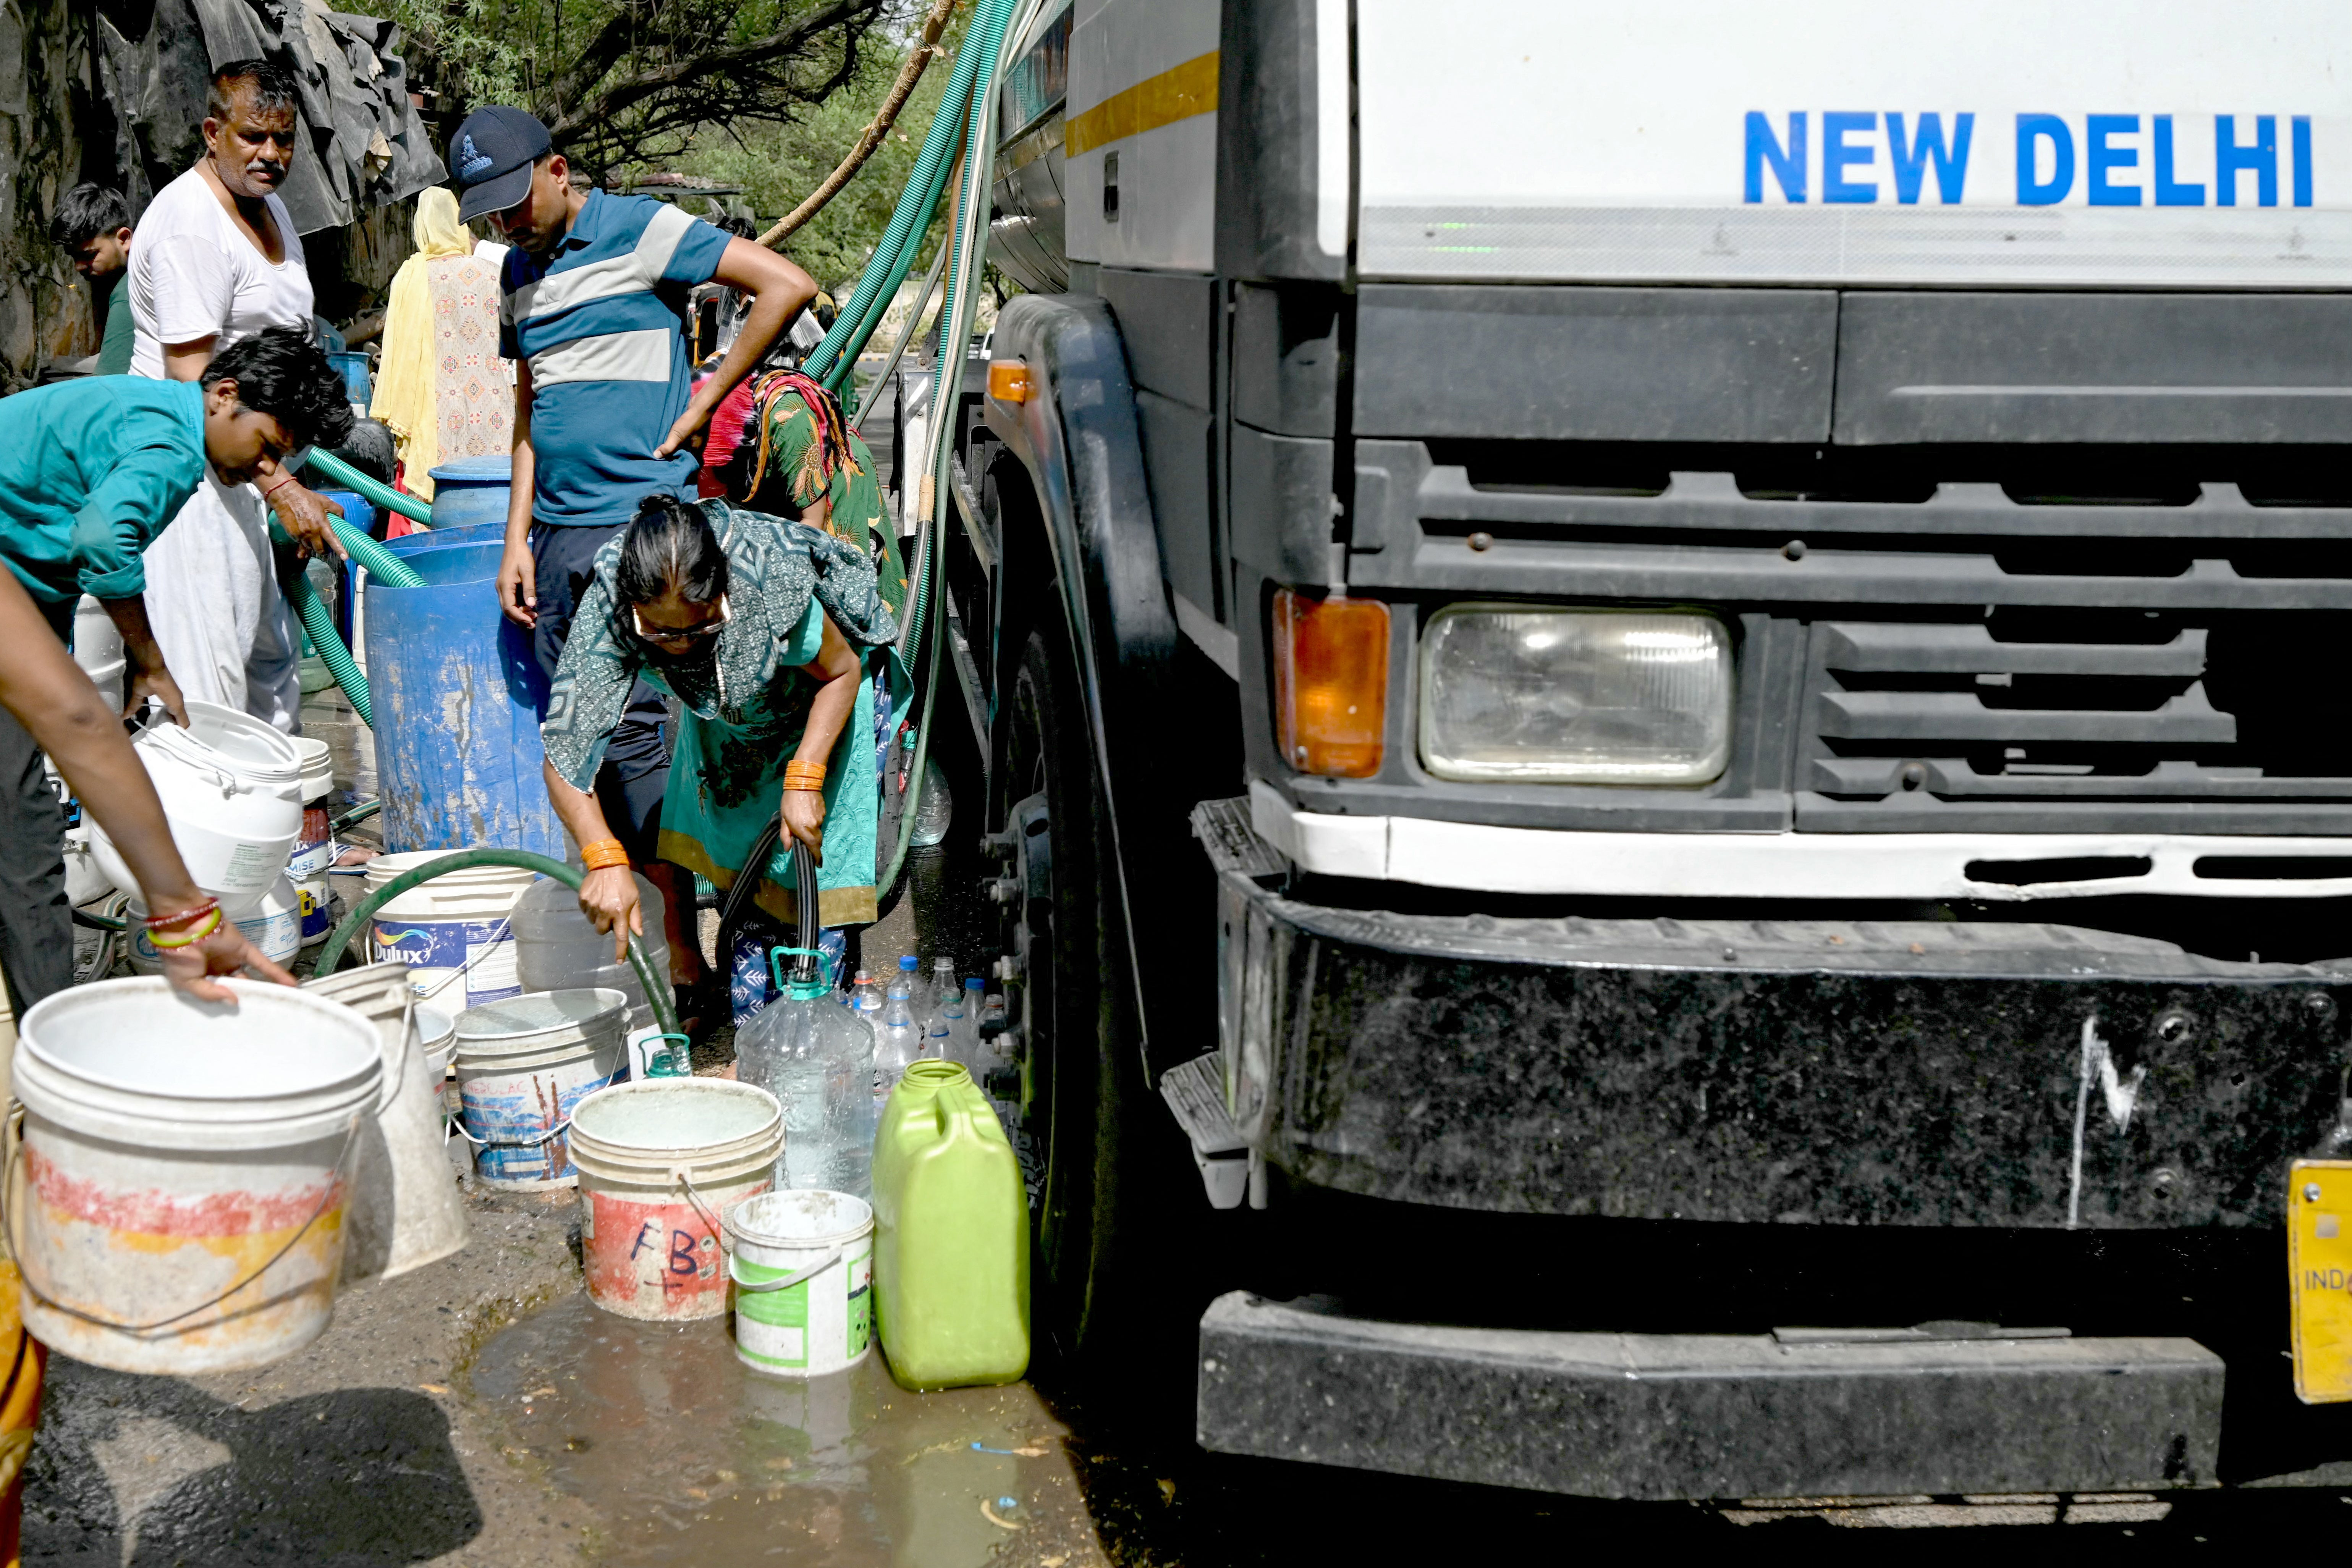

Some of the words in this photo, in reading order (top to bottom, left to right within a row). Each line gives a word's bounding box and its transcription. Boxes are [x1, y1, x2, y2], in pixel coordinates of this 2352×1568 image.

[1743, 110, 1975, 204] NEW
[2015, 113, 2314, 207] DELHI
[375, 941, 423, 964] Dulux
[2305, 1269, 2344, 1290] IND
